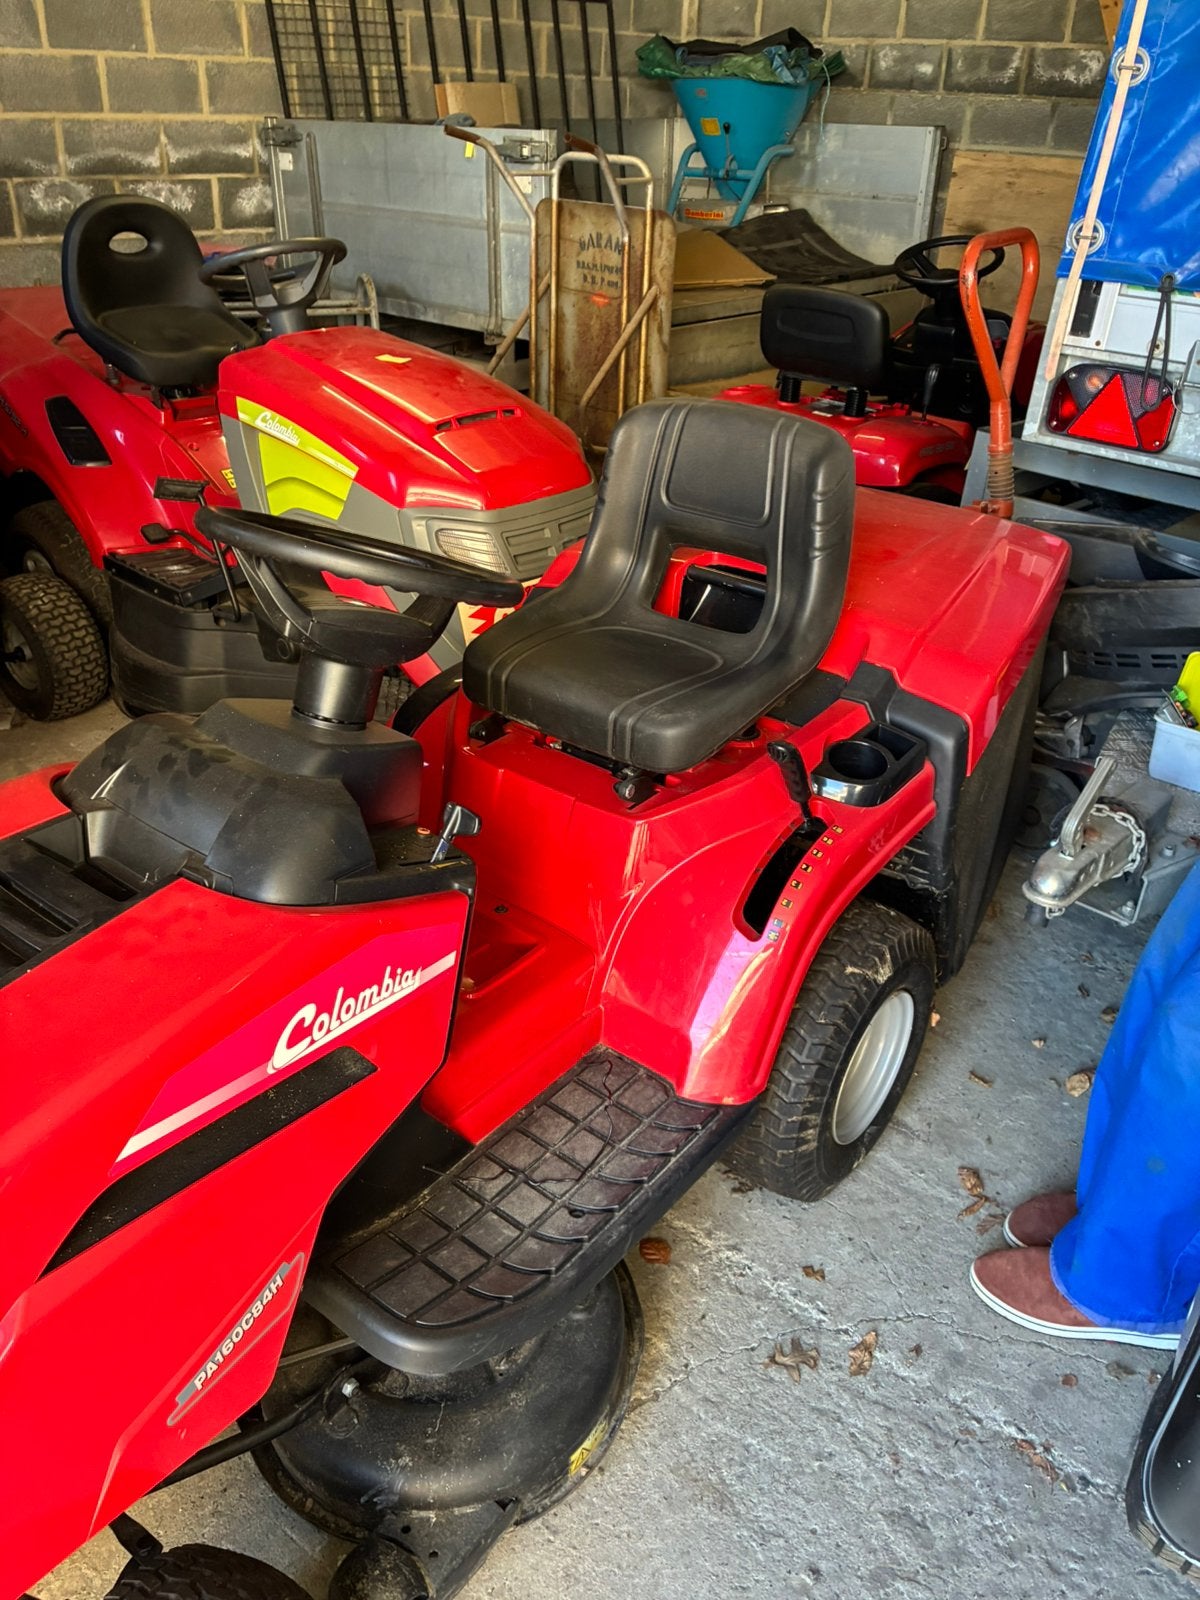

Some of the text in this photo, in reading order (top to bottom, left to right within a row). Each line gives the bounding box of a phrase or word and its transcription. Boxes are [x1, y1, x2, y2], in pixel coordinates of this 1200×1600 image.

[255, 411, 300, 446] Colombia
[267, 966, 422, 1074] Colombia
[193, 1274, 284, 1391] PA160C84H
